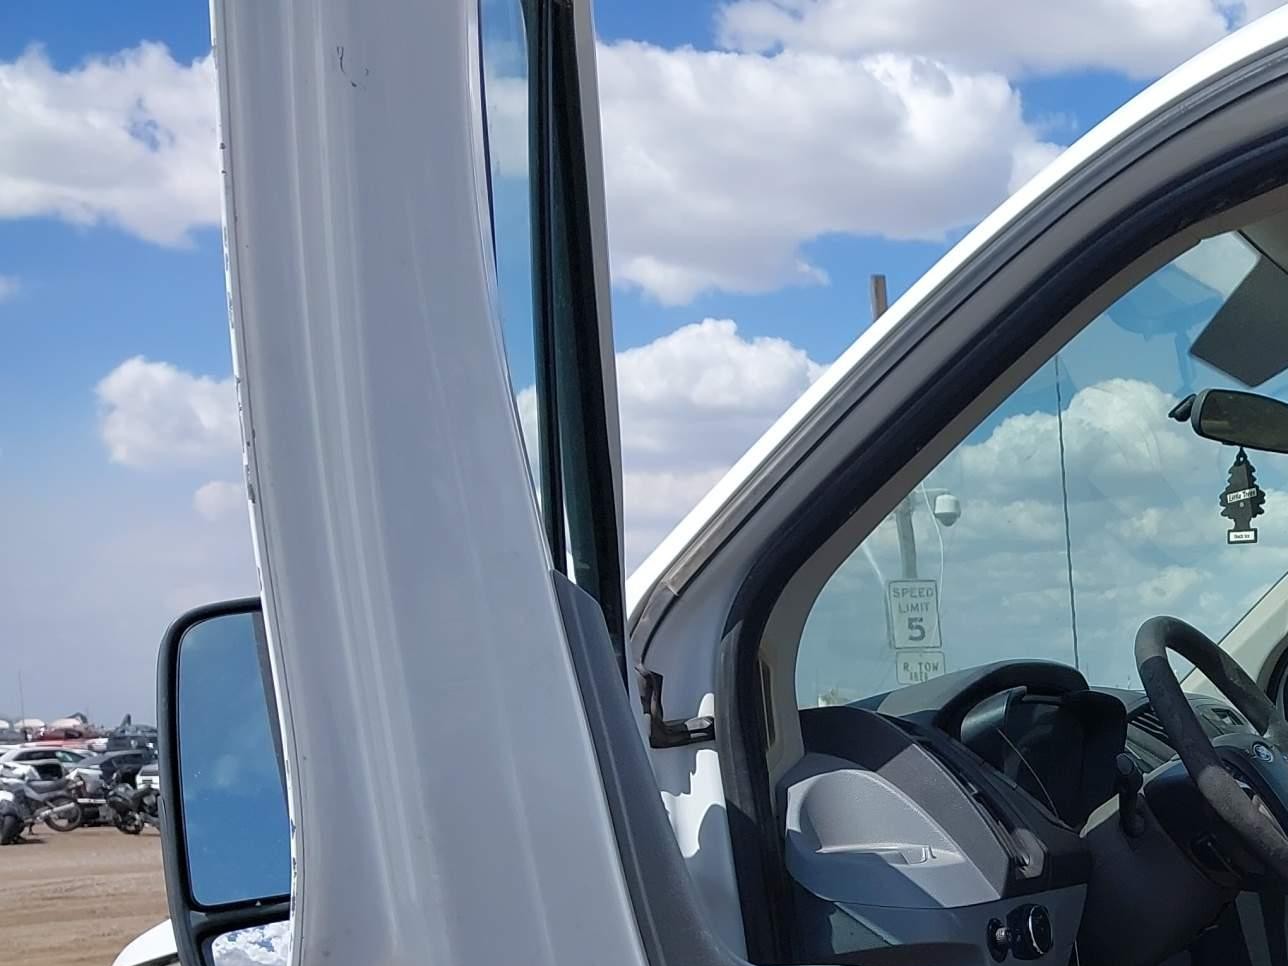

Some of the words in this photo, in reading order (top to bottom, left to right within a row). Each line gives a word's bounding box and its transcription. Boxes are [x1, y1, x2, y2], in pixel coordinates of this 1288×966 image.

[892, 587, 934, 598] SPEED
[898, 602, 929, 613] LIMIT
[907, 617, 926, 641] 5
[918, 662, 939, 672] TOW
